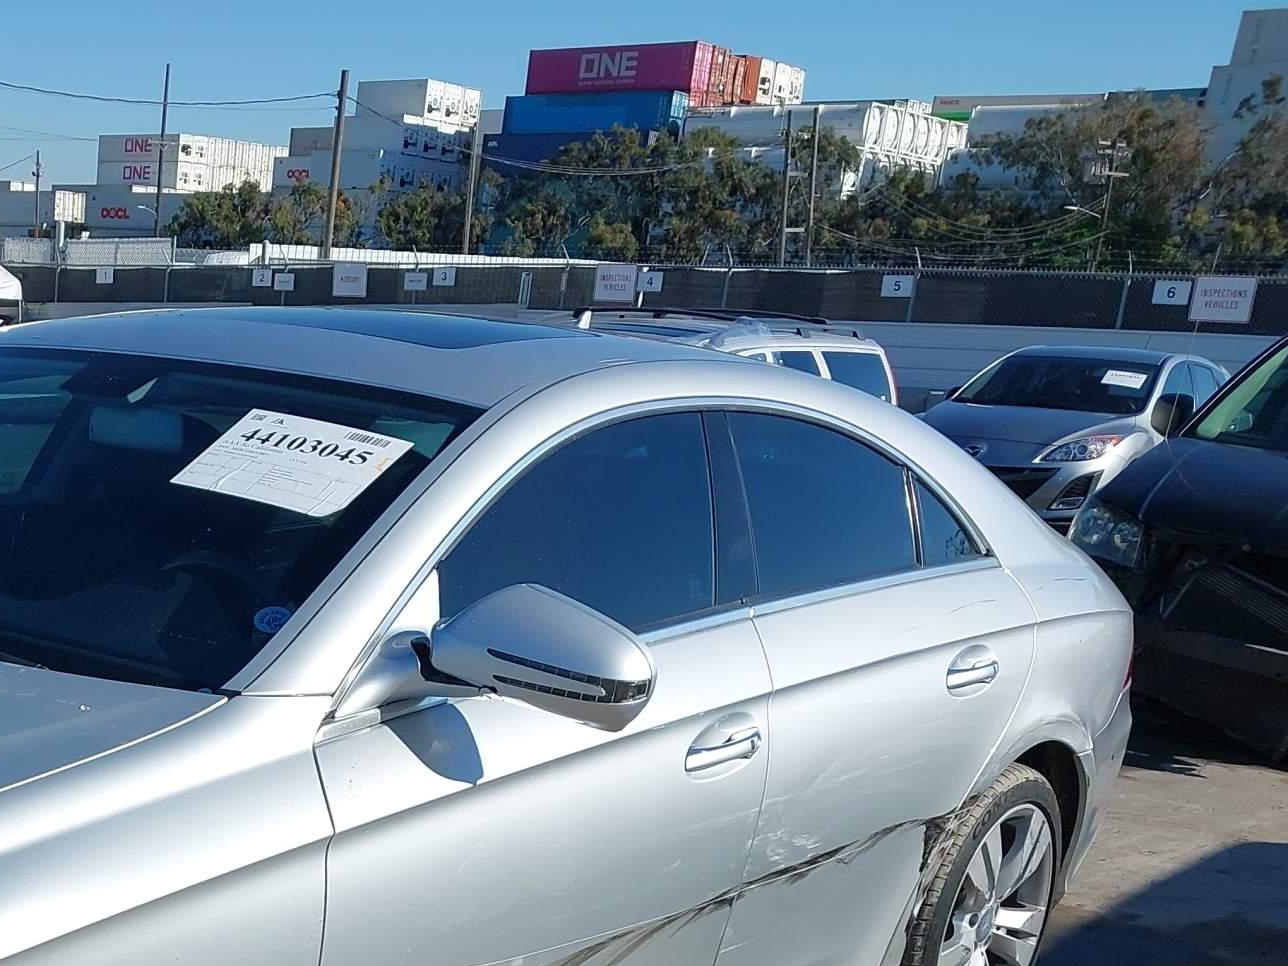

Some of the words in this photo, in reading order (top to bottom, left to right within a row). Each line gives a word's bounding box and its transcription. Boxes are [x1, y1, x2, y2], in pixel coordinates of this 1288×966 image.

[579, 52, 639, 78] ONE
[124, 137, 153, 153] ONE
[122, 165, 151, 181] ONE
[100, 207, 130, 220] OOCL
[103, 272, 108, 281] 1
[258, 273, 265, 282] 2
[440, 271, 448, 281] 3
[646, 276, 654, 287] 4
[893, 280, 902, 292] 5
[1167, 286, 1177, 299] 6
[1200, 288, 1248, 298] INSPECTIONS
[1204, 300, 1239, 310] VEHICLES
[240, 428, 374, 466] 44103045
